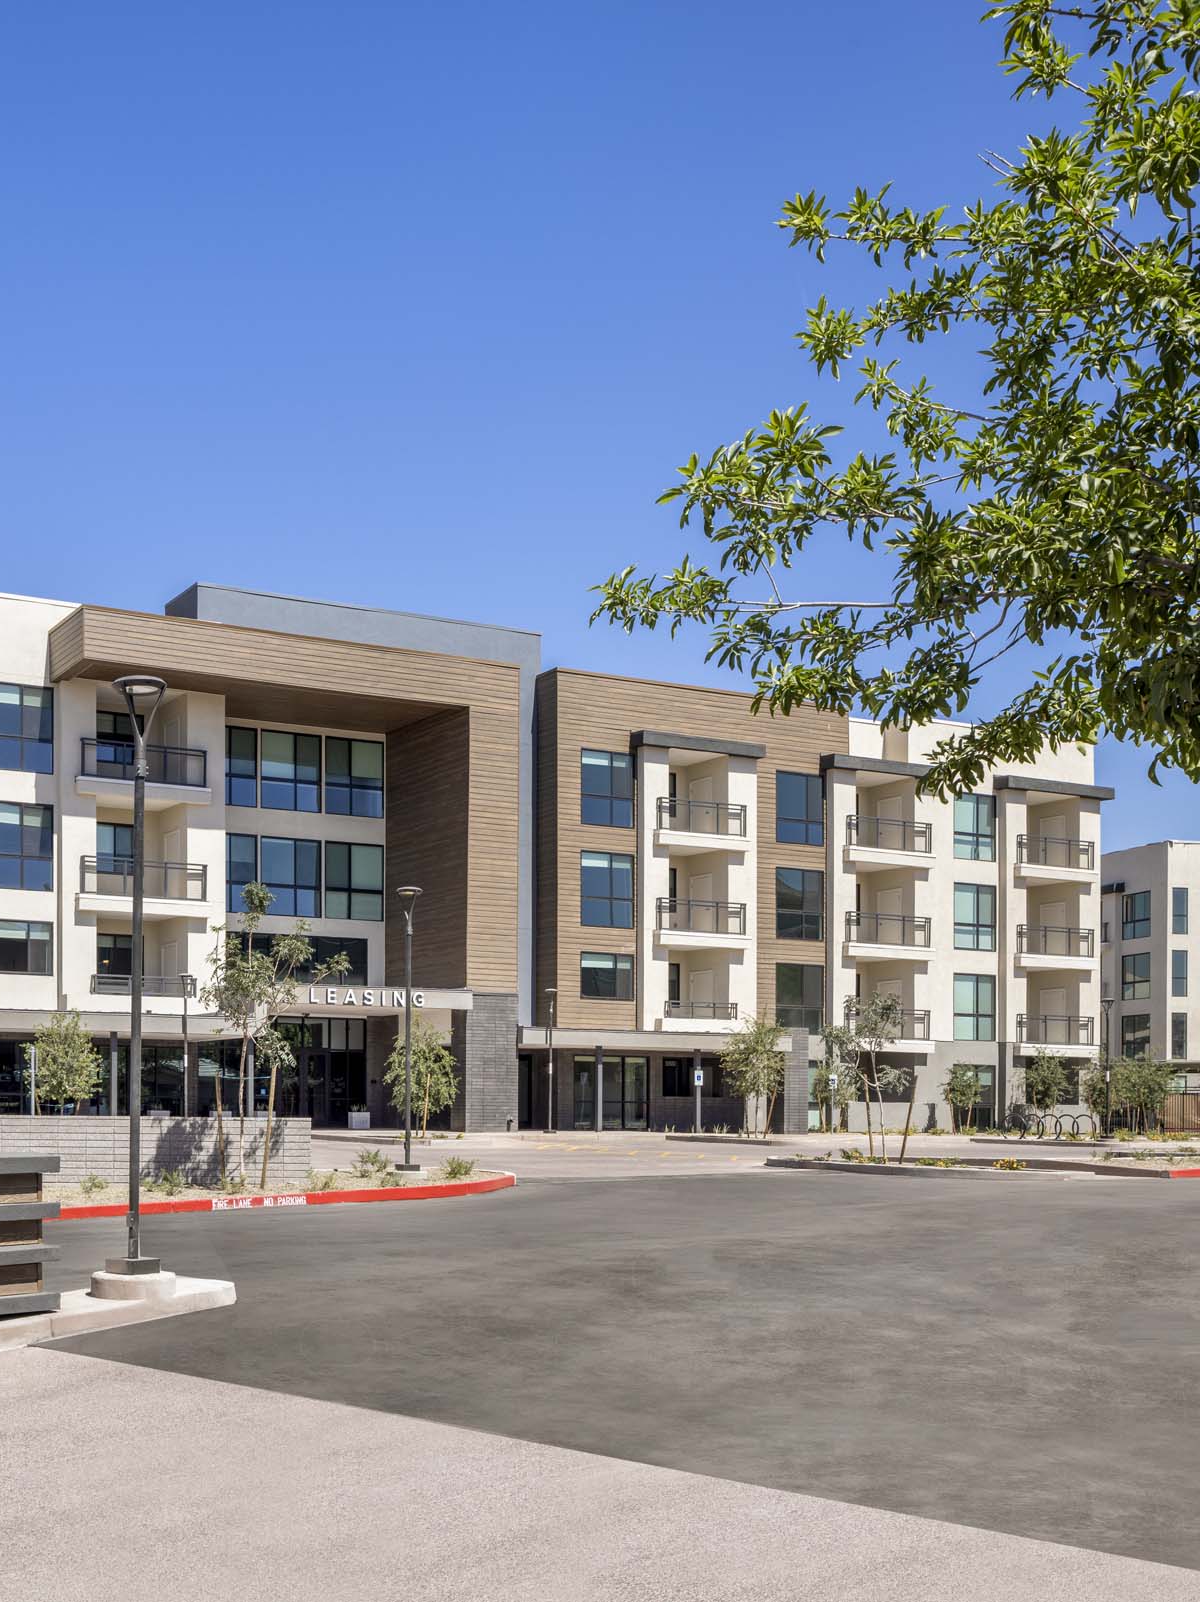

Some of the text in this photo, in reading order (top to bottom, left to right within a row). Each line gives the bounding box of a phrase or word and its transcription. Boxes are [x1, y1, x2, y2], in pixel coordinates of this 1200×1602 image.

[310, 987, 425, 1008] LEASING
[212, 1195, 307, 1210] FIRE LANE NO PARKING
